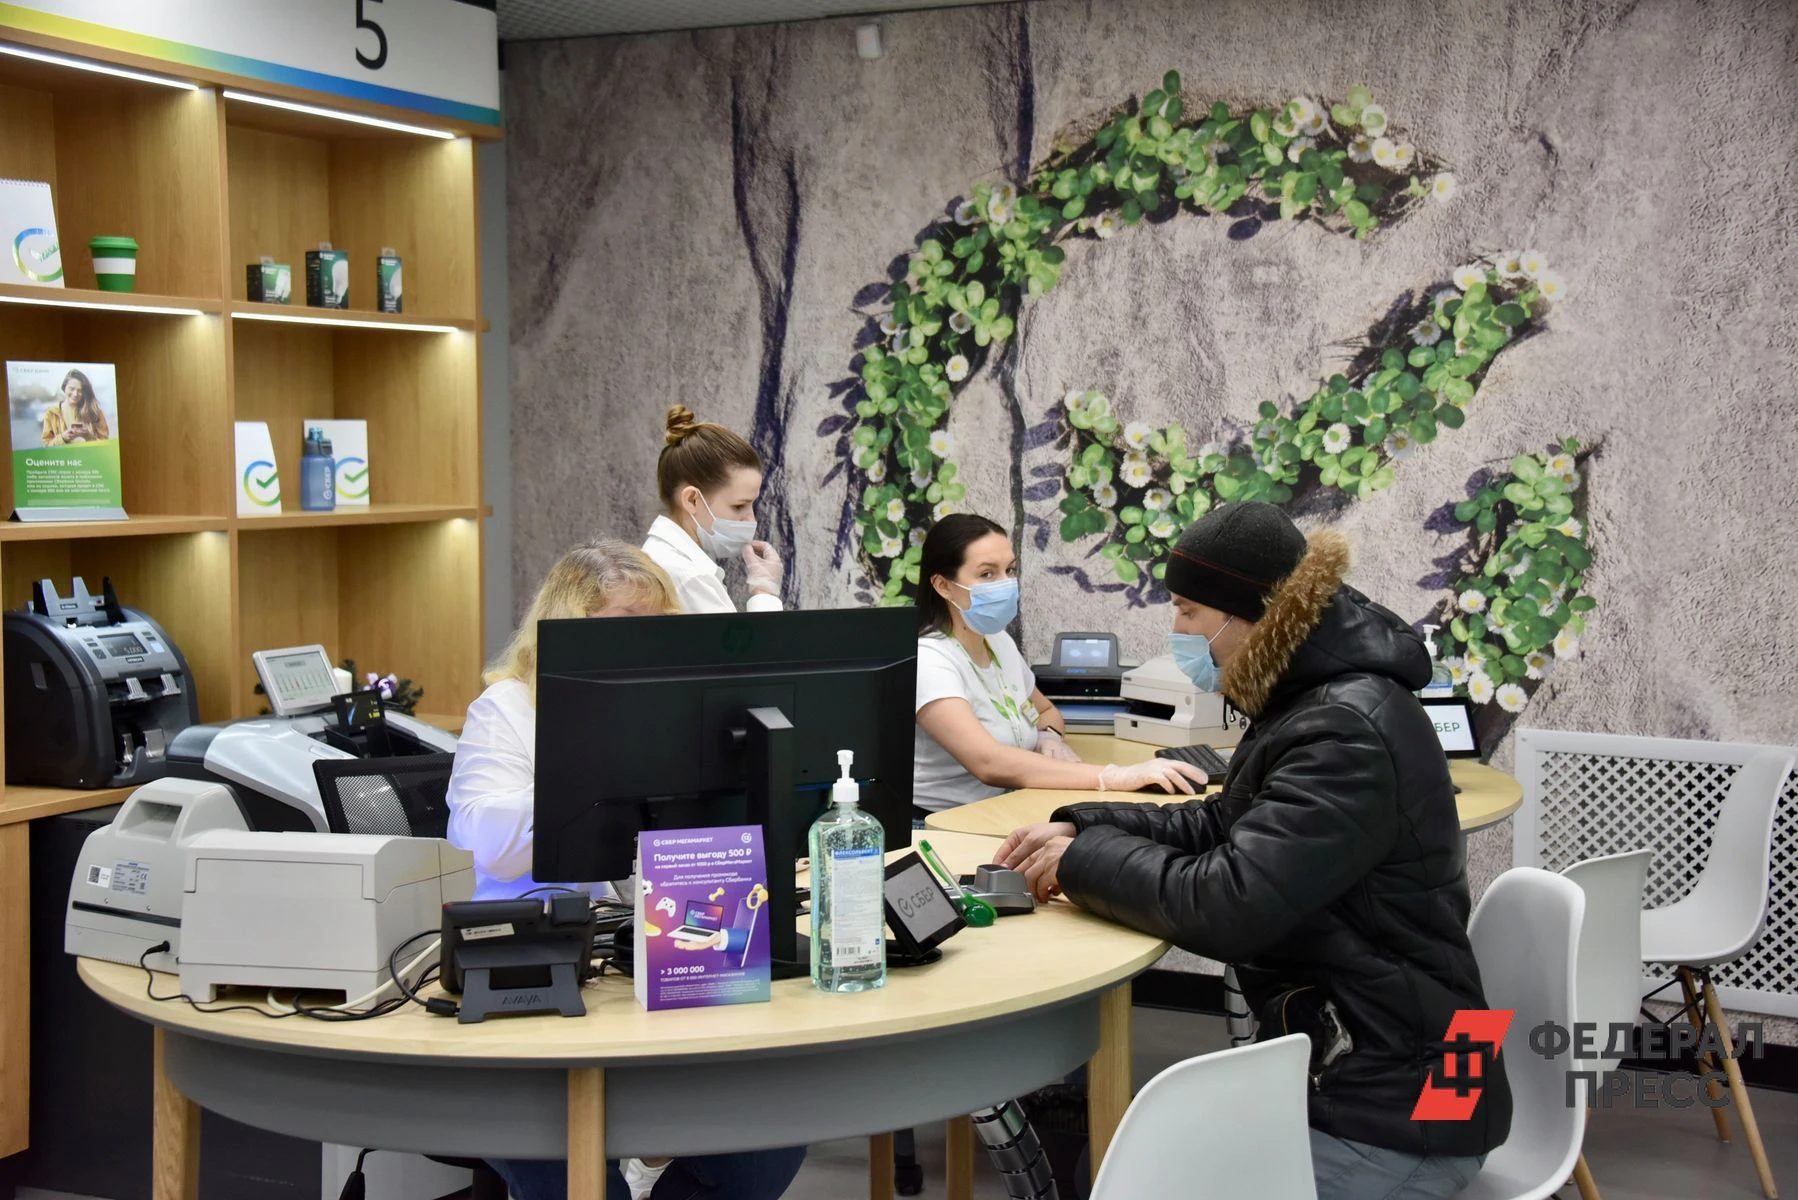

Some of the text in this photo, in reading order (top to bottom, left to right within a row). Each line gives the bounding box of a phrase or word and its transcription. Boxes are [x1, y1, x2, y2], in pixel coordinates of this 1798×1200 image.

[356, 0, 388, 70] 5
[25, 458, 65, 467] Оцените
[1434, 722, 1460, 732] БЕР
[654, 853, 695, 862] Получите
[697, 851, 726, 859] выгоду
[728, 849, 744, 857] 500
[911, 886, 935, 909] СБЕР
[673, 967, 689, 975] 000
[690, 965, 705, 974] 000
[502, 994, 542, 1006] AVAYA
